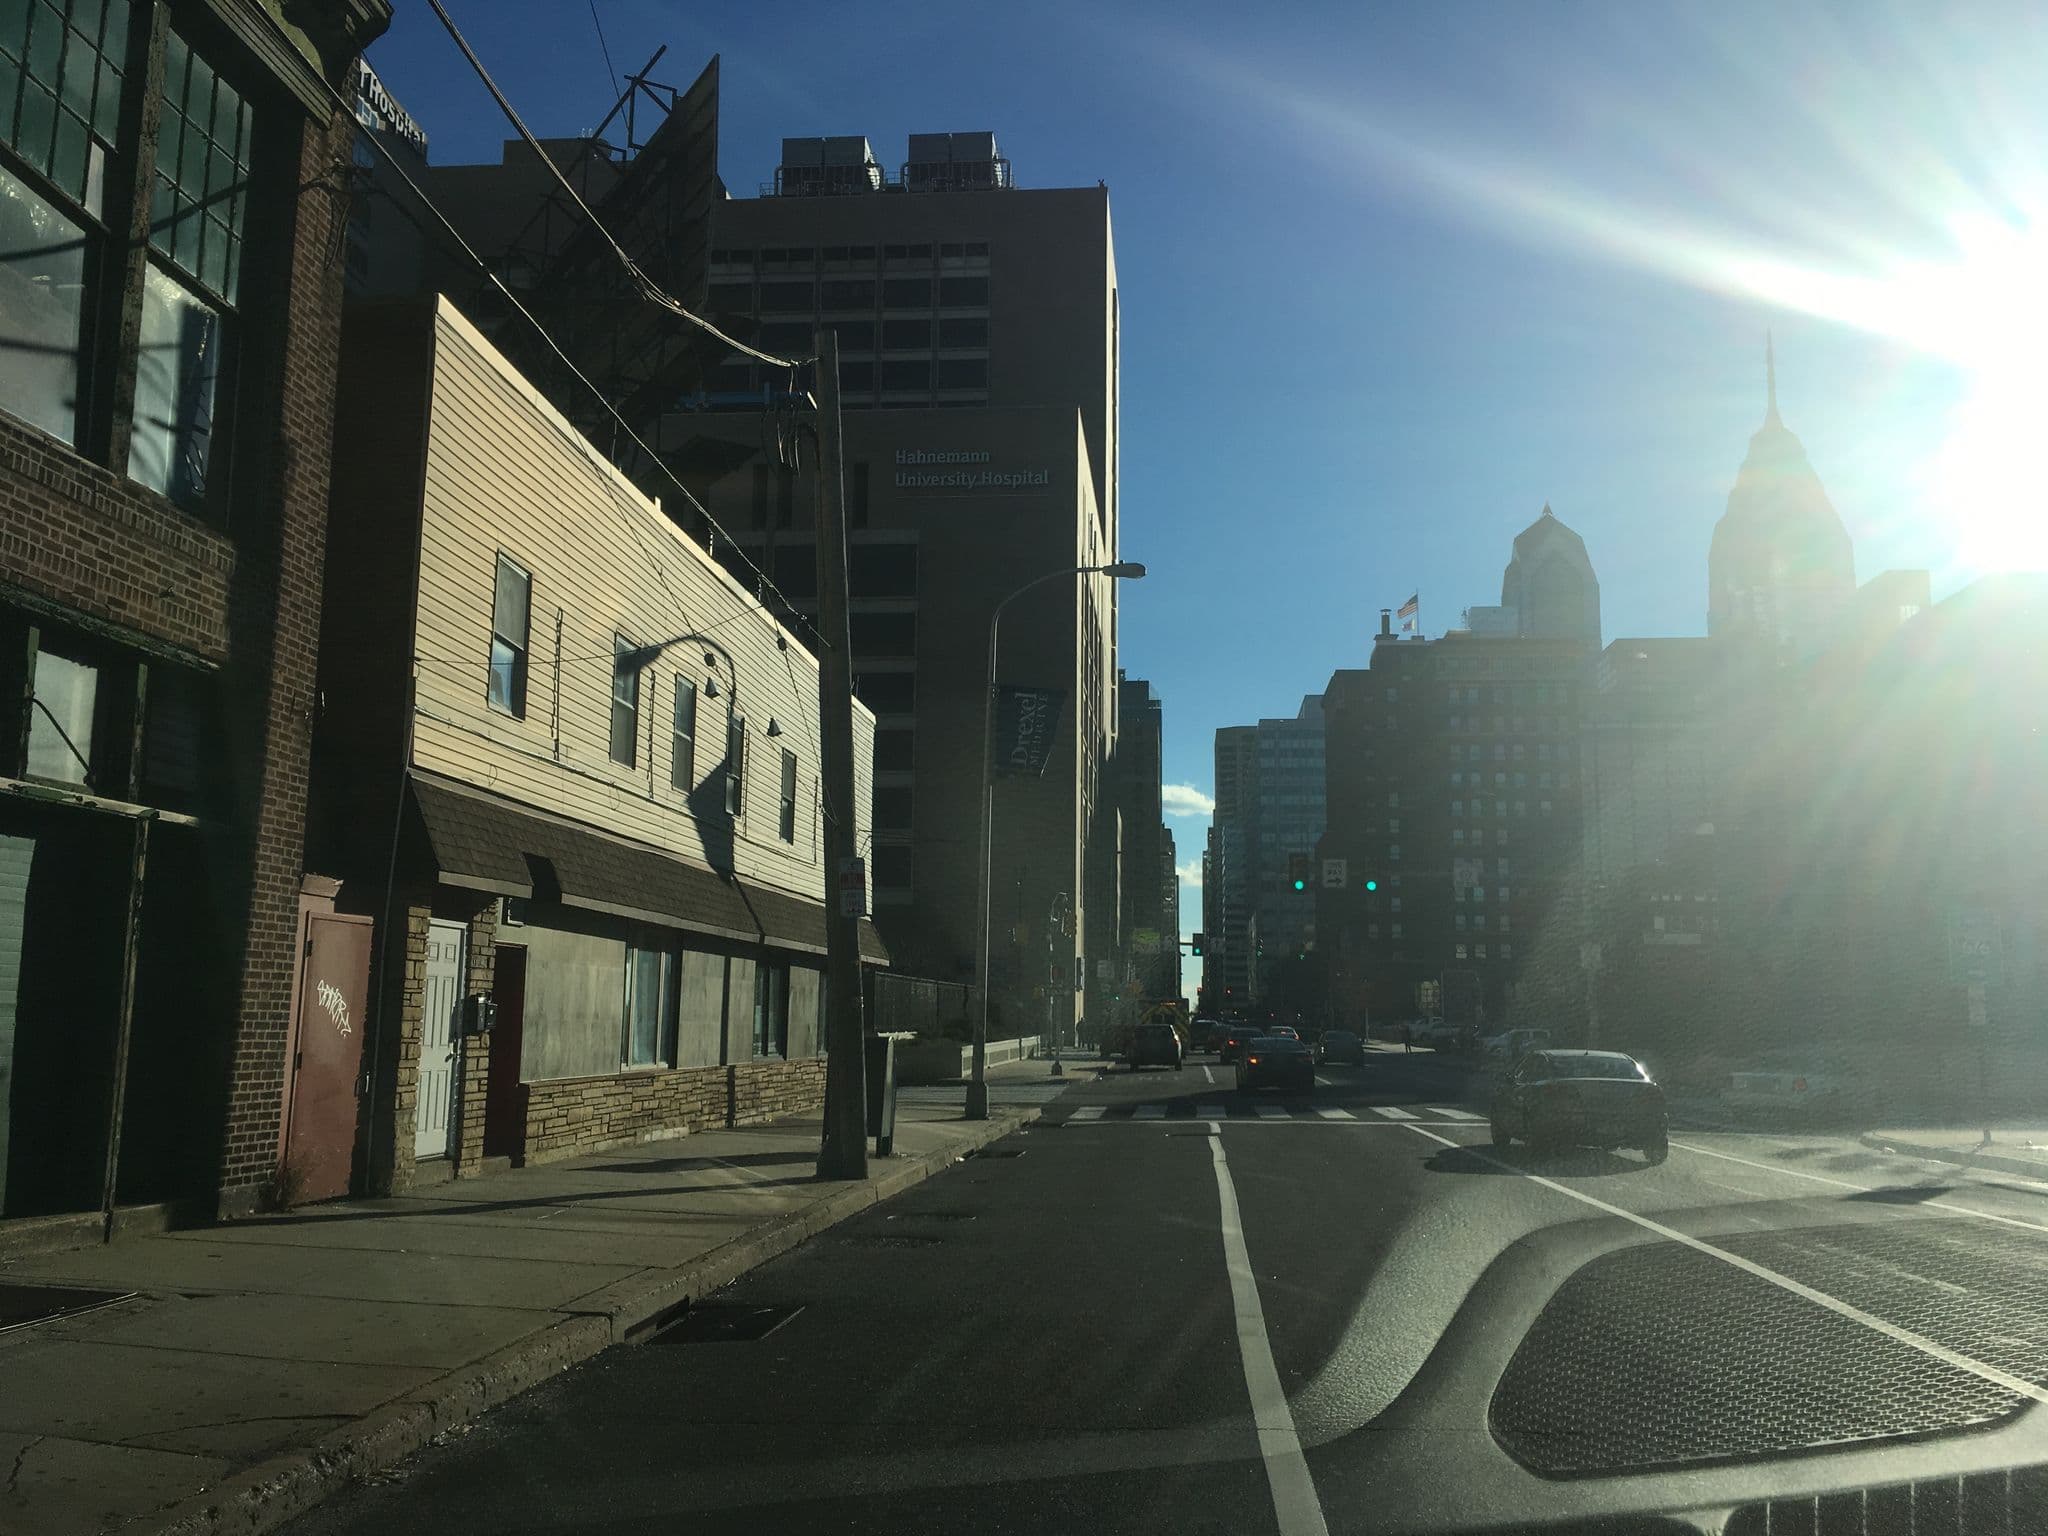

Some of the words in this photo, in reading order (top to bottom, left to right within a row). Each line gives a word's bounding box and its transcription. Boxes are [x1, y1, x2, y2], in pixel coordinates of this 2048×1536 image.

[896, 449, 991, 465] Hahnemann
[896, 470, 977, 489] University
[981, 469, 1049, 488] Hospital
[1010, 692, 1037, 768] Drexel
